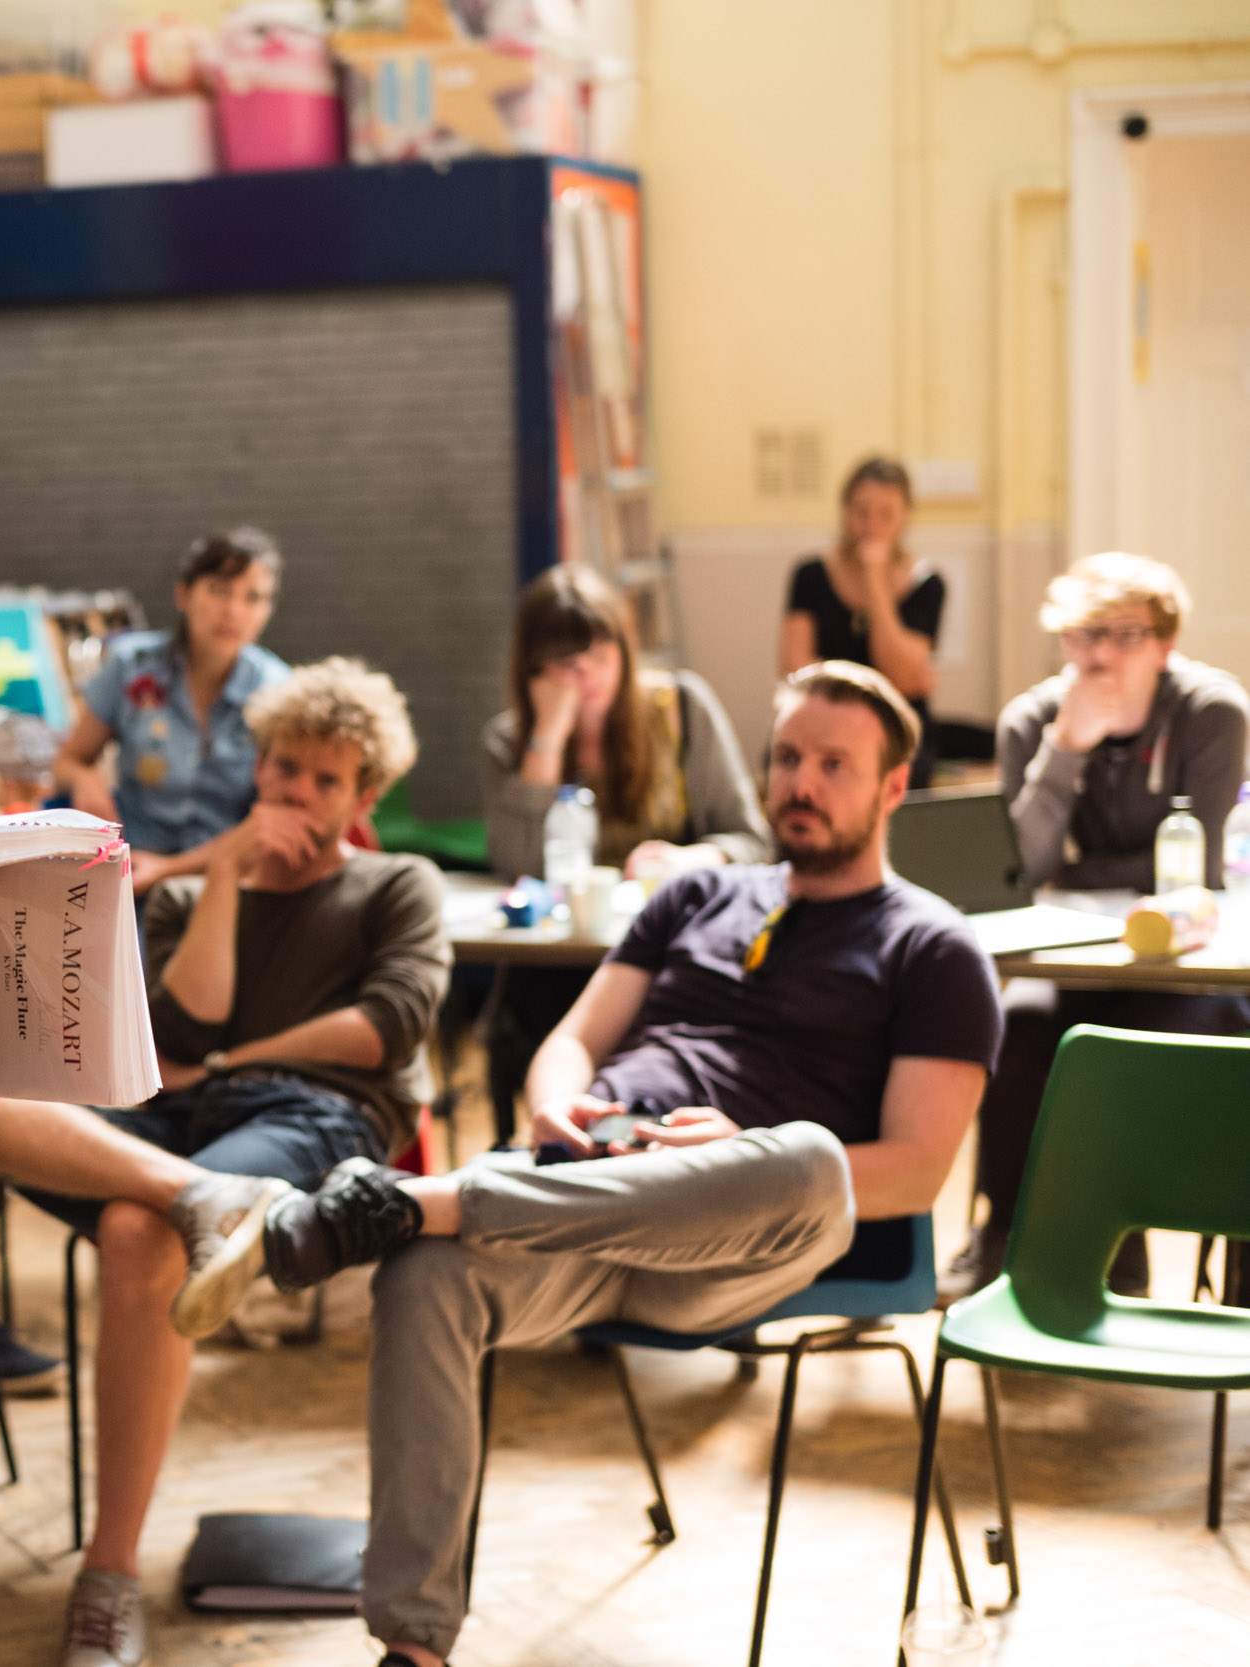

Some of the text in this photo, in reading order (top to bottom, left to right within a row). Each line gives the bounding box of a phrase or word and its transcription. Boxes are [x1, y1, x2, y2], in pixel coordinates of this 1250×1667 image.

[4, 955, 12, 970] KV
[13, 907, 28, 1040] The Magic Flute
